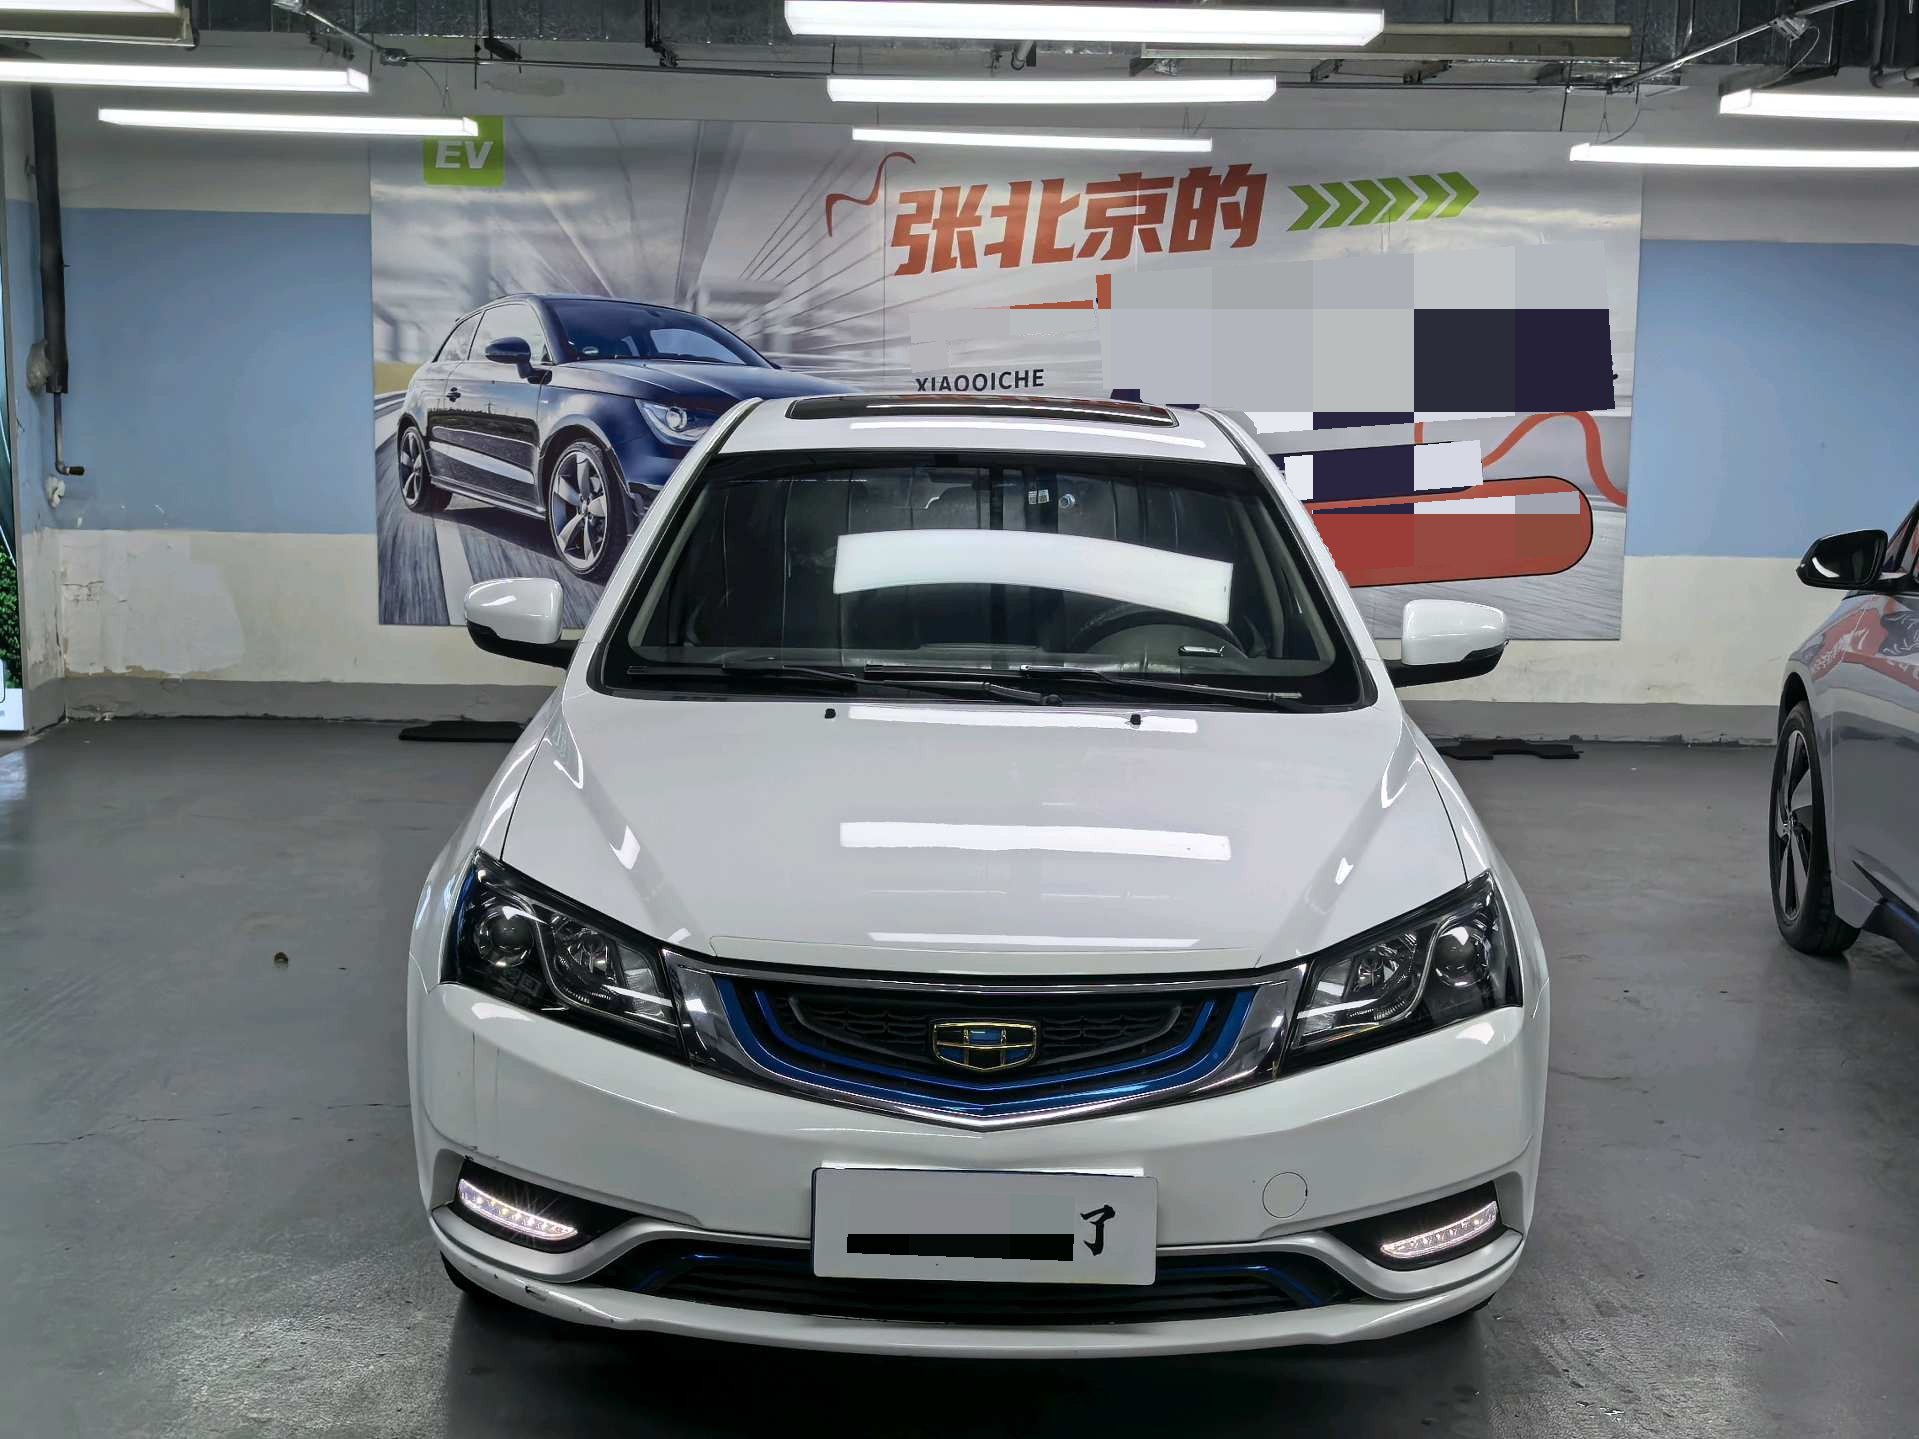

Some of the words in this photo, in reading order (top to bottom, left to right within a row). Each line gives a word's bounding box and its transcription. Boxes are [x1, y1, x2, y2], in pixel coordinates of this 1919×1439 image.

[435, 140, 494, 169] EV
[891, 163, 1268, 276] 张北京的
